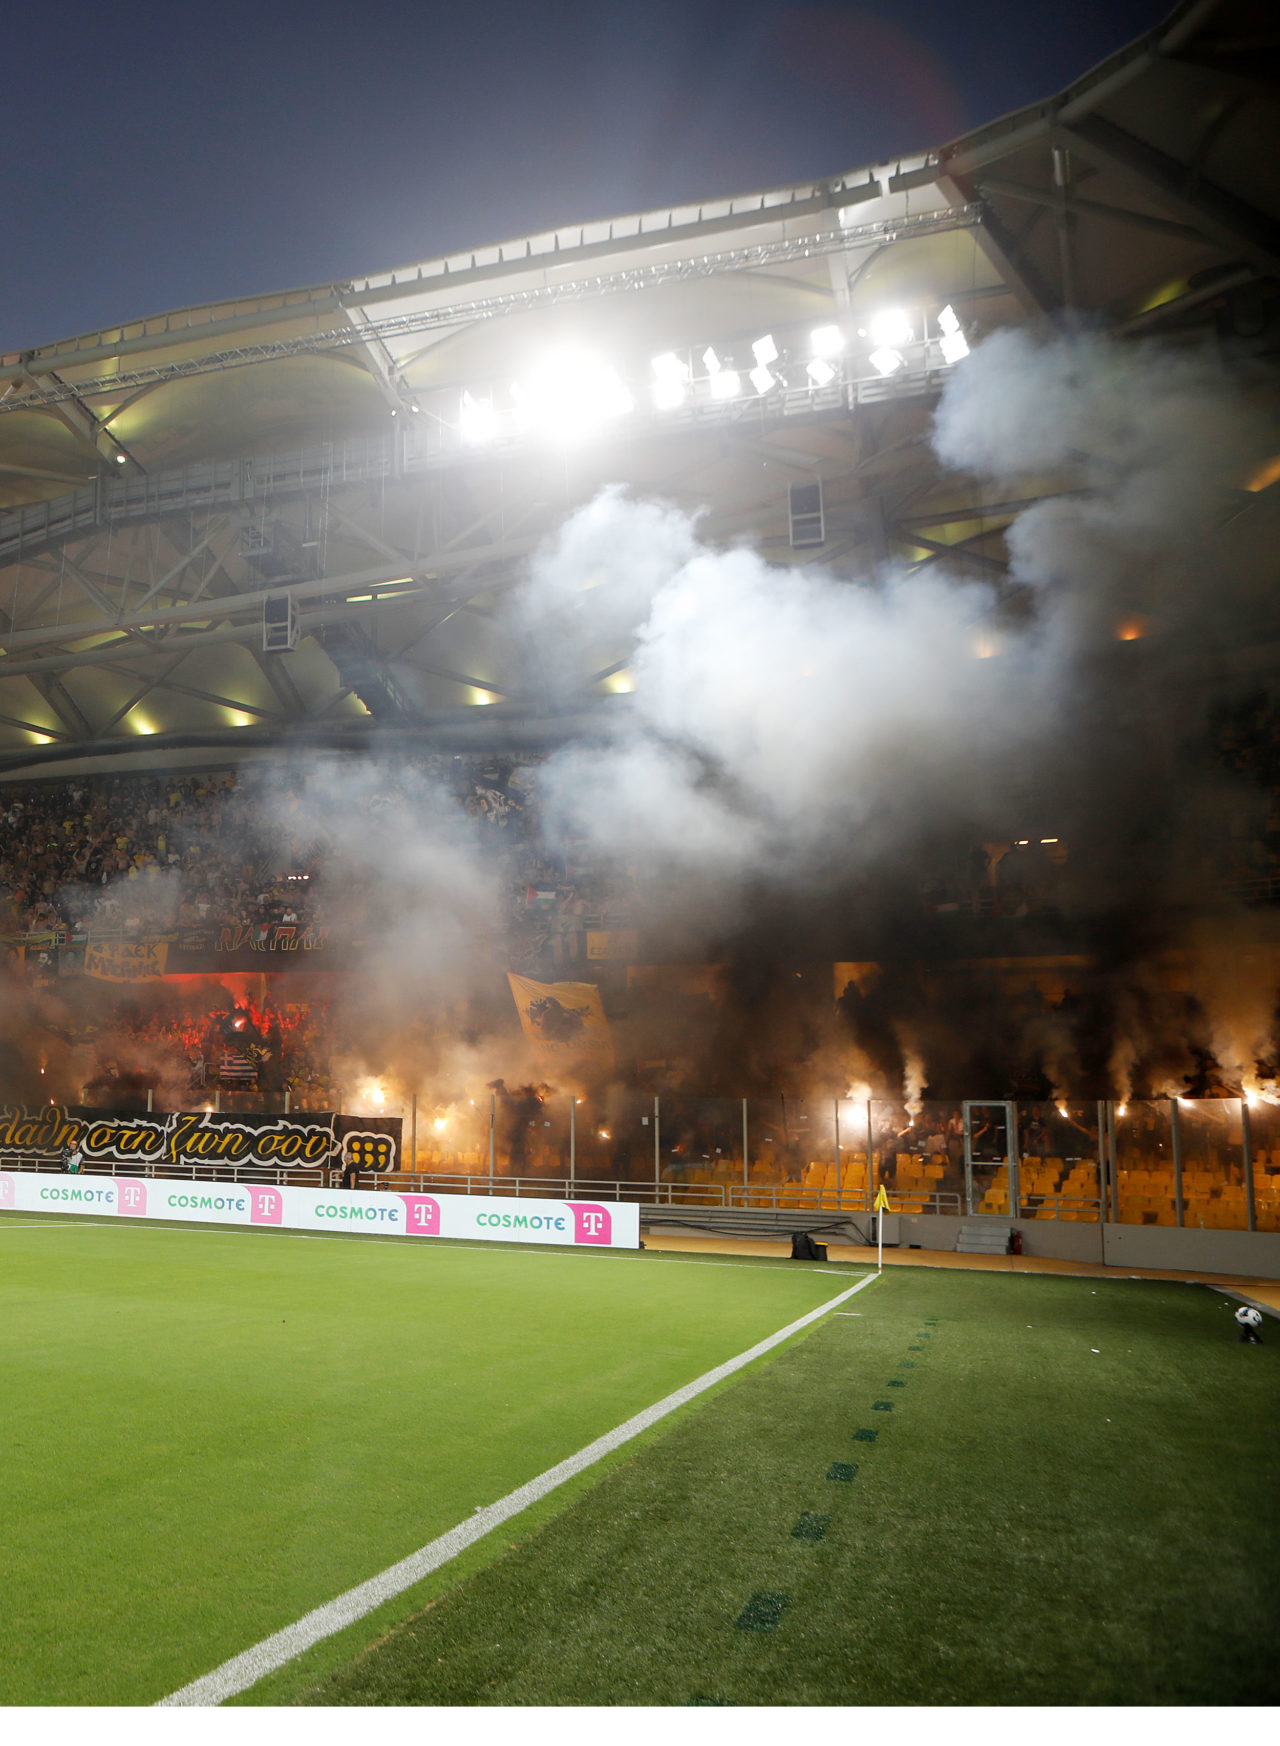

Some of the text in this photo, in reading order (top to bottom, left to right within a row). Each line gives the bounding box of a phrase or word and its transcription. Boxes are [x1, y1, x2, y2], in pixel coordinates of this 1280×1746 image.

[40, 1187, 115, 1203] COSMOTE
[168, 1195, 245, 1211] COSMOTE
[315, 1204, 399, 1222] COSMOTE
[476, 1213, 566, 1230] COSMOTE
